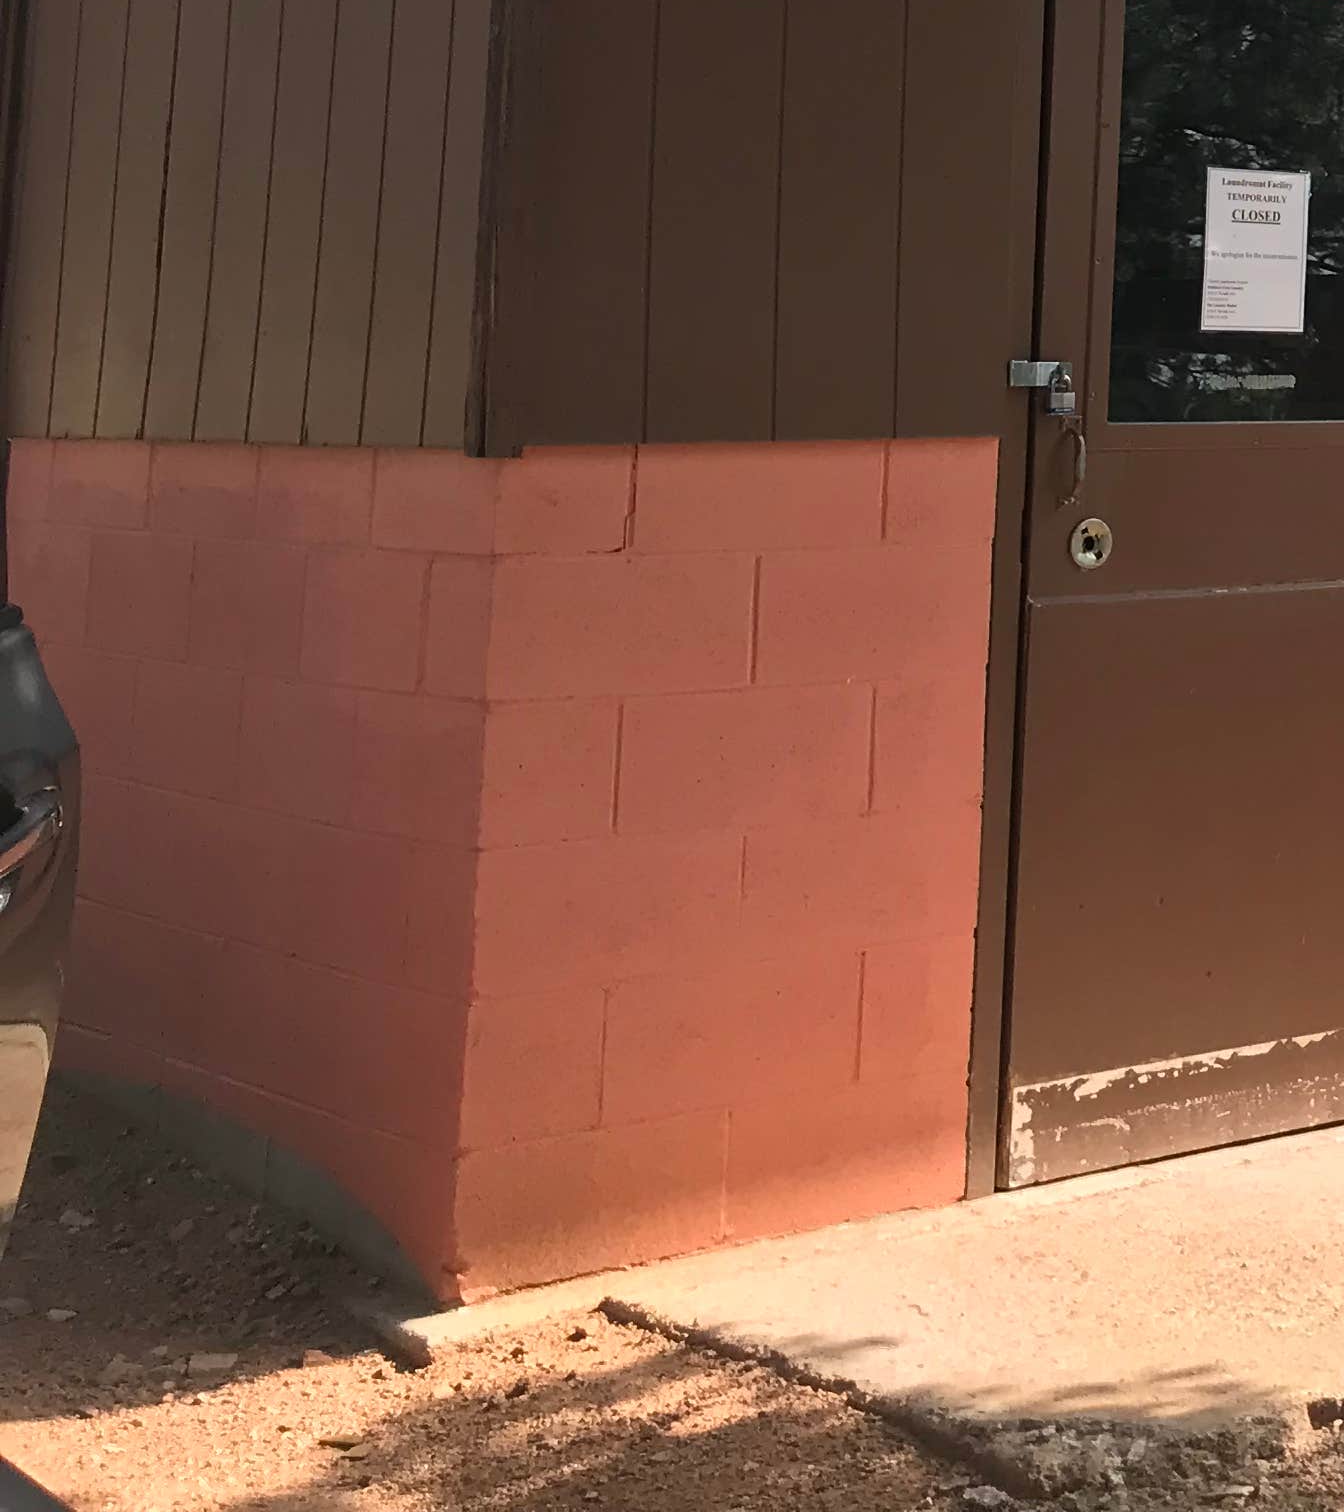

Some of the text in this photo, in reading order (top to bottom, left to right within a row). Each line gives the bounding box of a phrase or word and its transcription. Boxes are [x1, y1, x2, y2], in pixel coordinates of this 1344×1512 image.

[1222, 177, 1266, 188] Laundromat
[1227, 192, 1288, 204] TEMPORARILY
[1232, 208, 1281, 223] CLOSED
